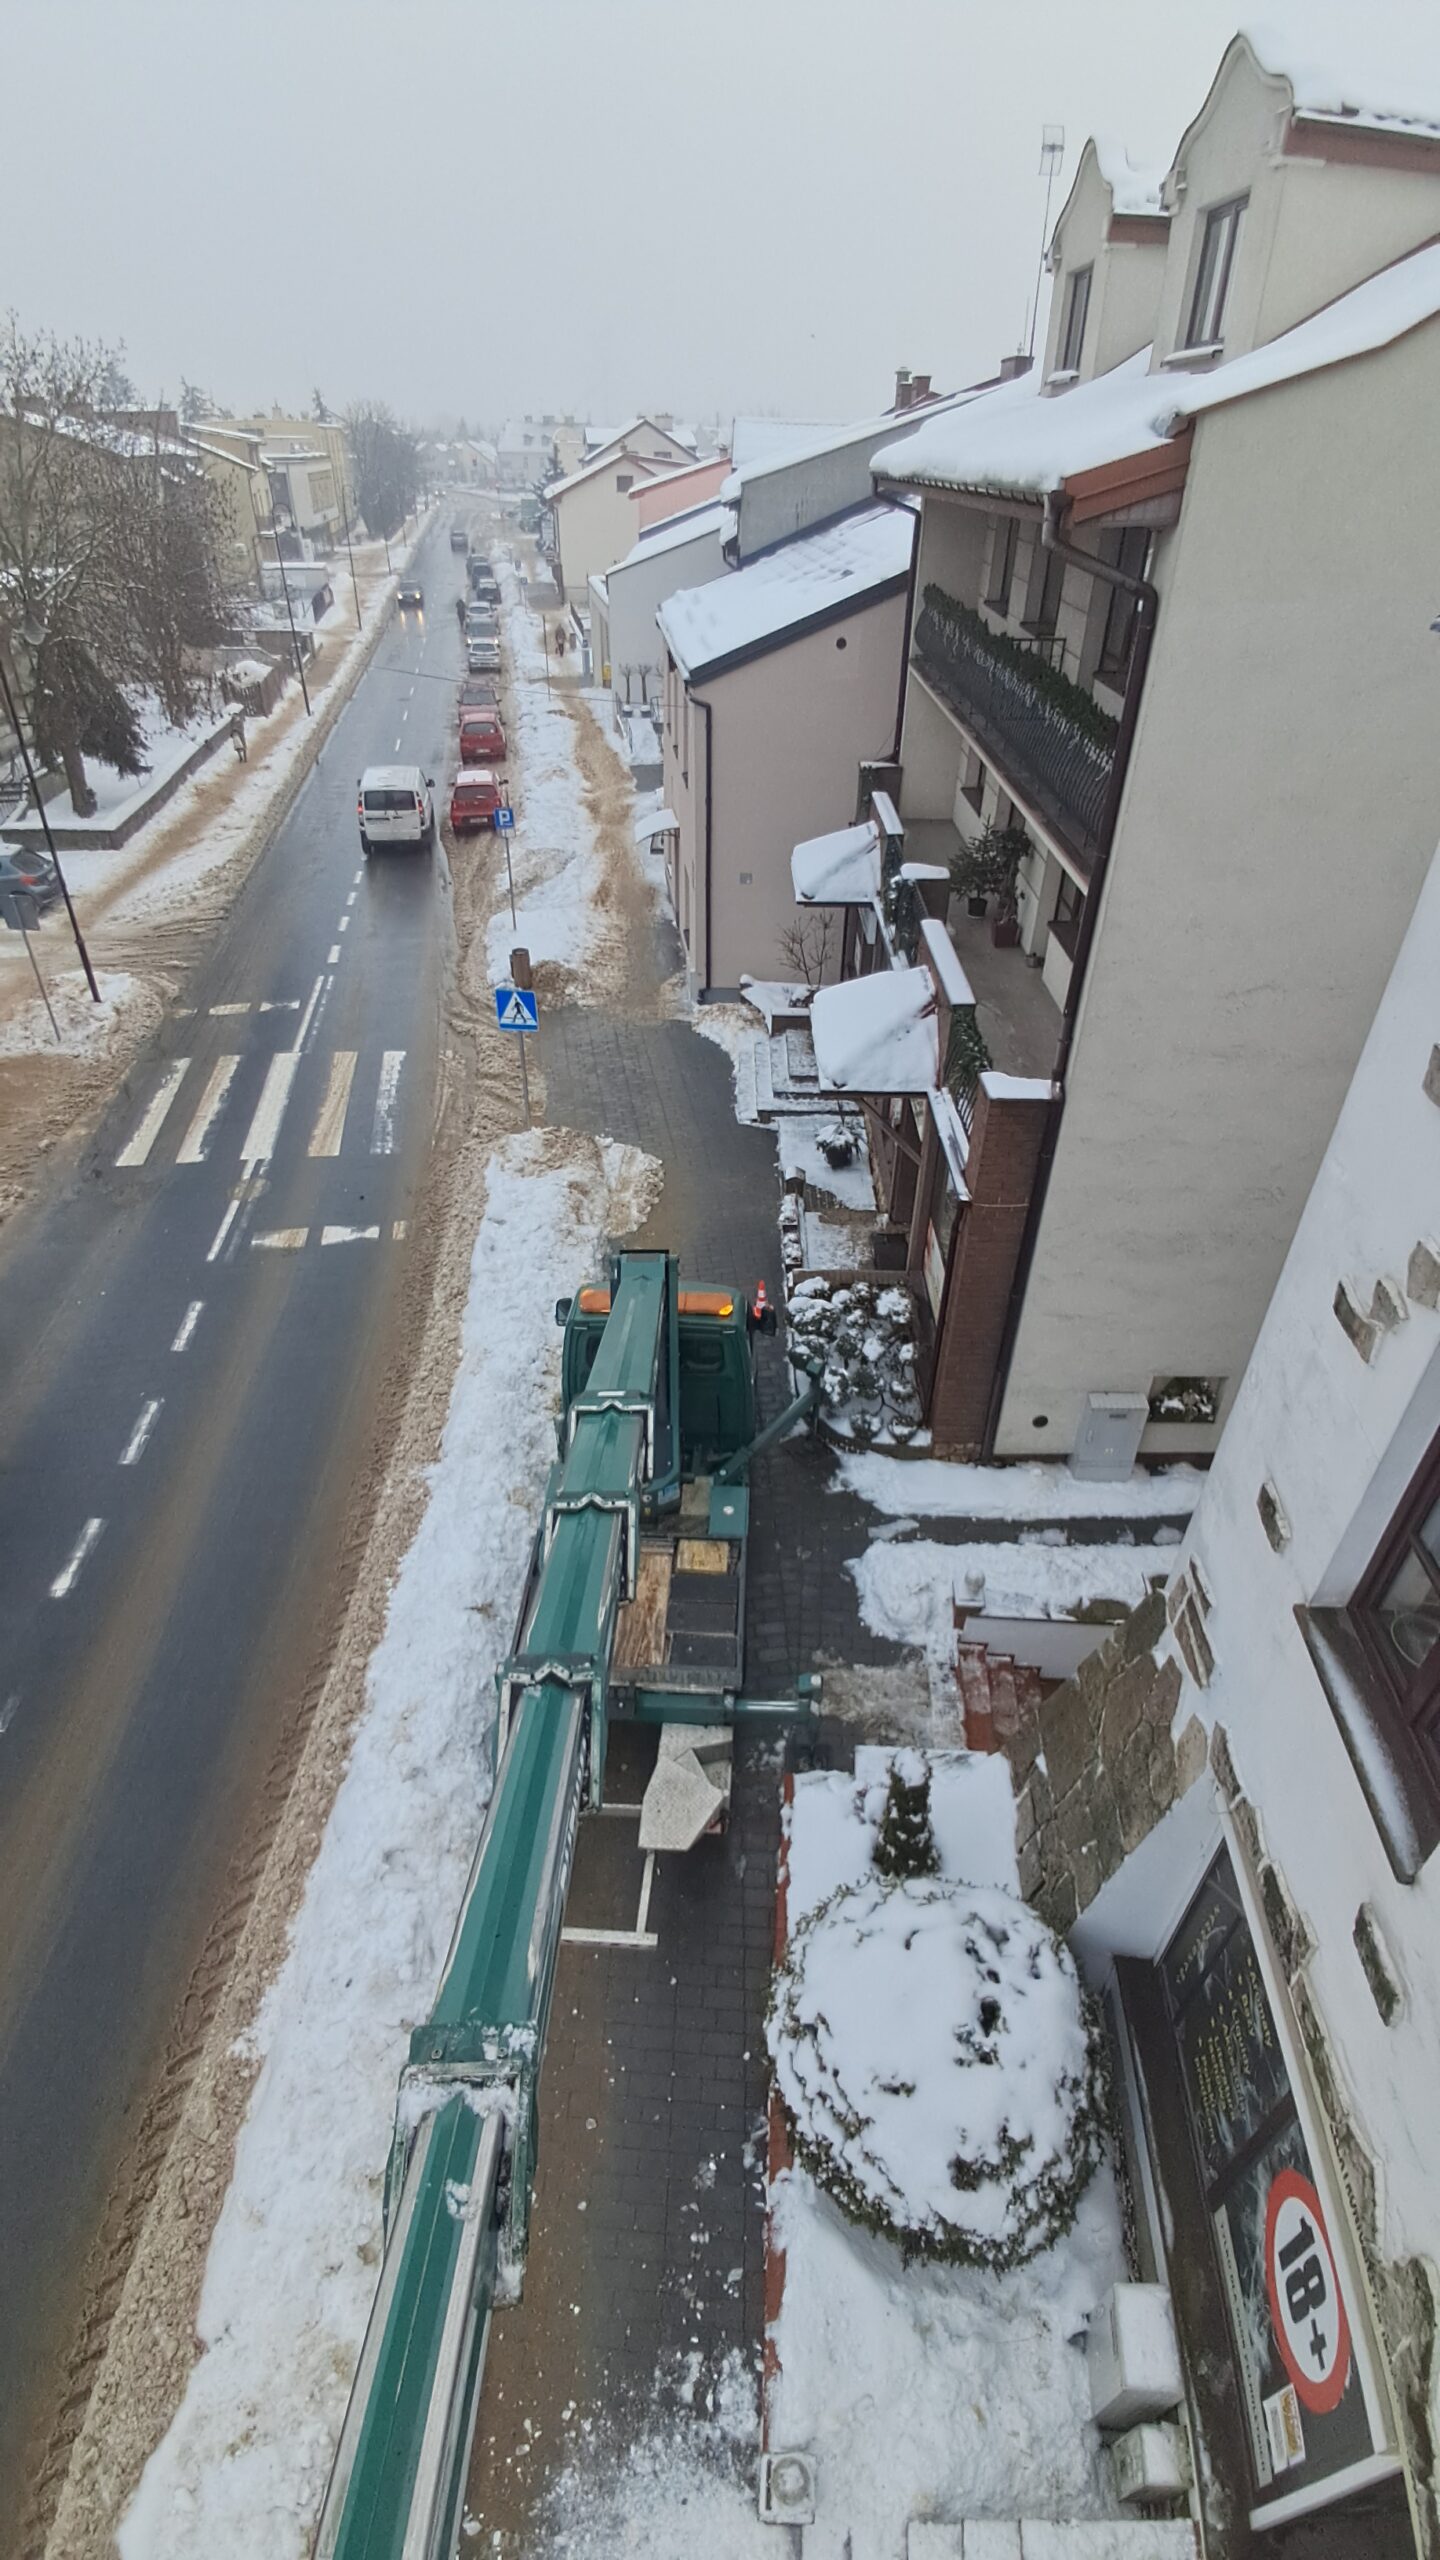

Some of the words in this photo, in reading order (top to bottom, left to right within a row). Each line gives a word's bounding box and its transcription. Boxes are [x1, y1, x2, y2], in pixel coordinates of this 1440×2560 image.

[499, 810, 511, 826] P
[1231, 2008, 1251, 2075] Liquidy
[1241, 1993, 1256, 2037] Bazy
[1249, 1971, 1273, 2048] Aromaty
[1278, 2216, 1327, 2371] 18+
